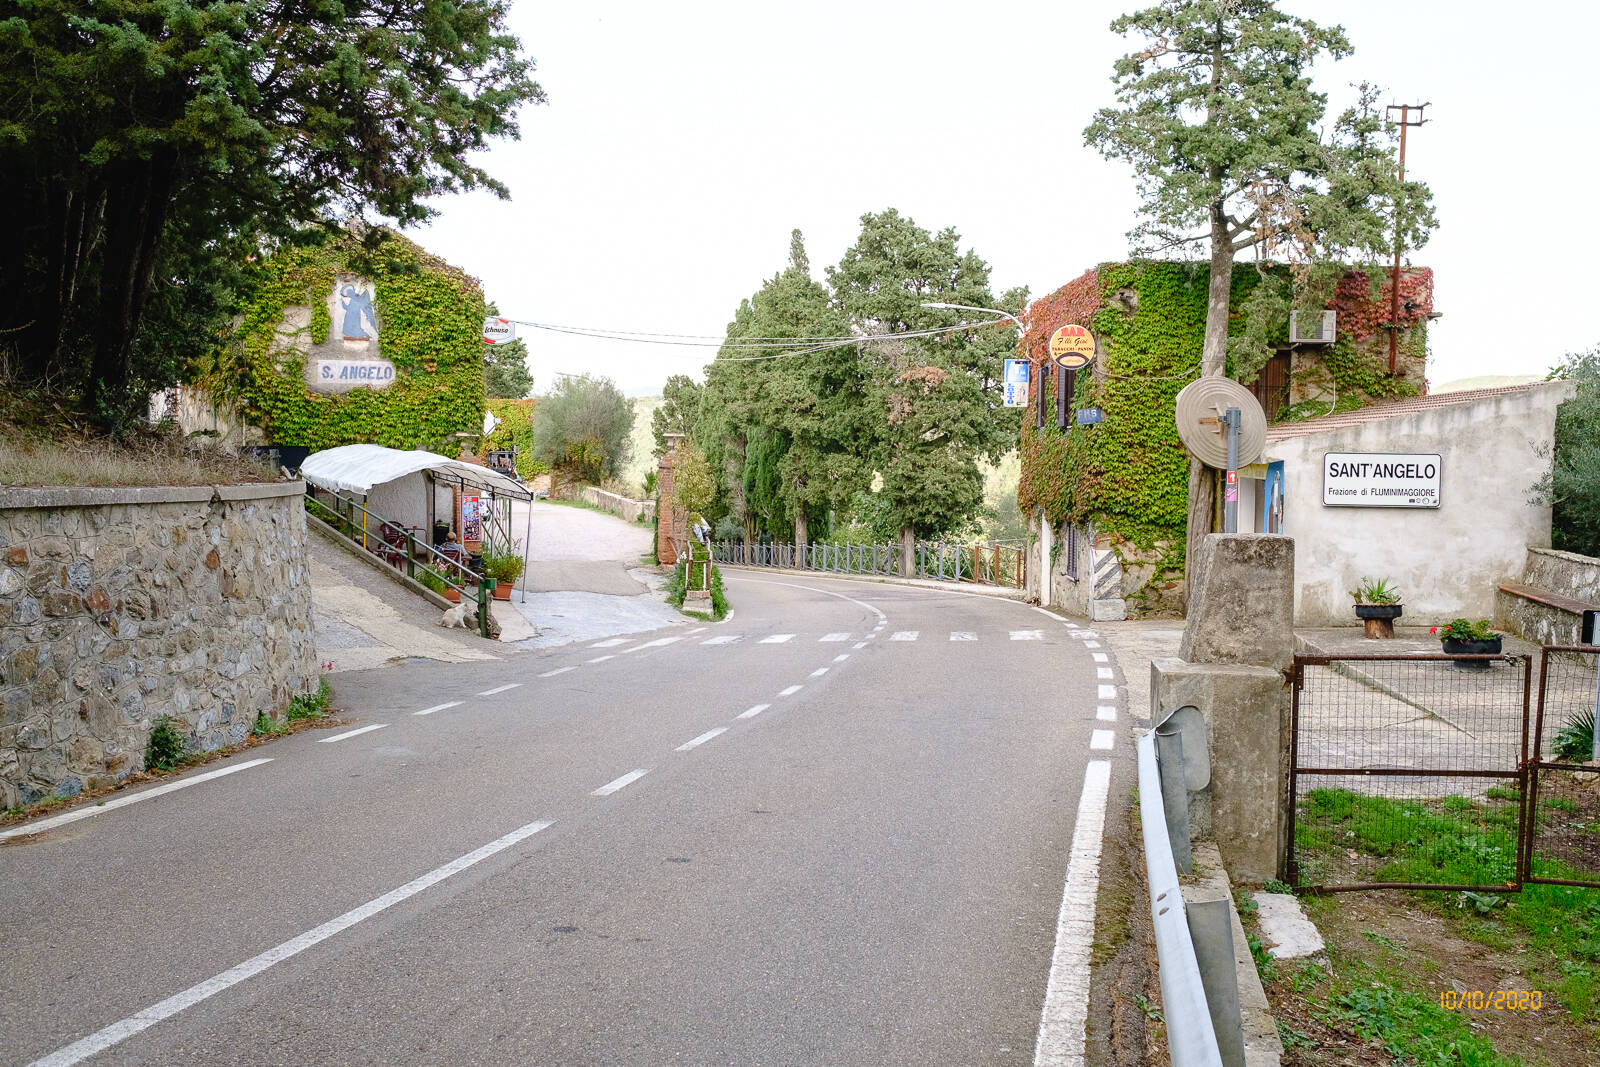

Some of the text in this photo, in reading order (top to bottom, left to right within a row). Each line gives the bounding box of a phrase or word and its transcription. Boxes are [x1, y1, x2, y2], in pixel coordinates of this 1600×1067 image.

[1060, 327, 1085, 337] BAR
[340, 365, 393, 379] ANGELO
[1007, 383, 1015, 404] LOTTO
[1329, 462, 1436, 479] SANT'ANGELO
[1328, 487, 1435, 497] Frazione di FLUMINIMAGGIORE
